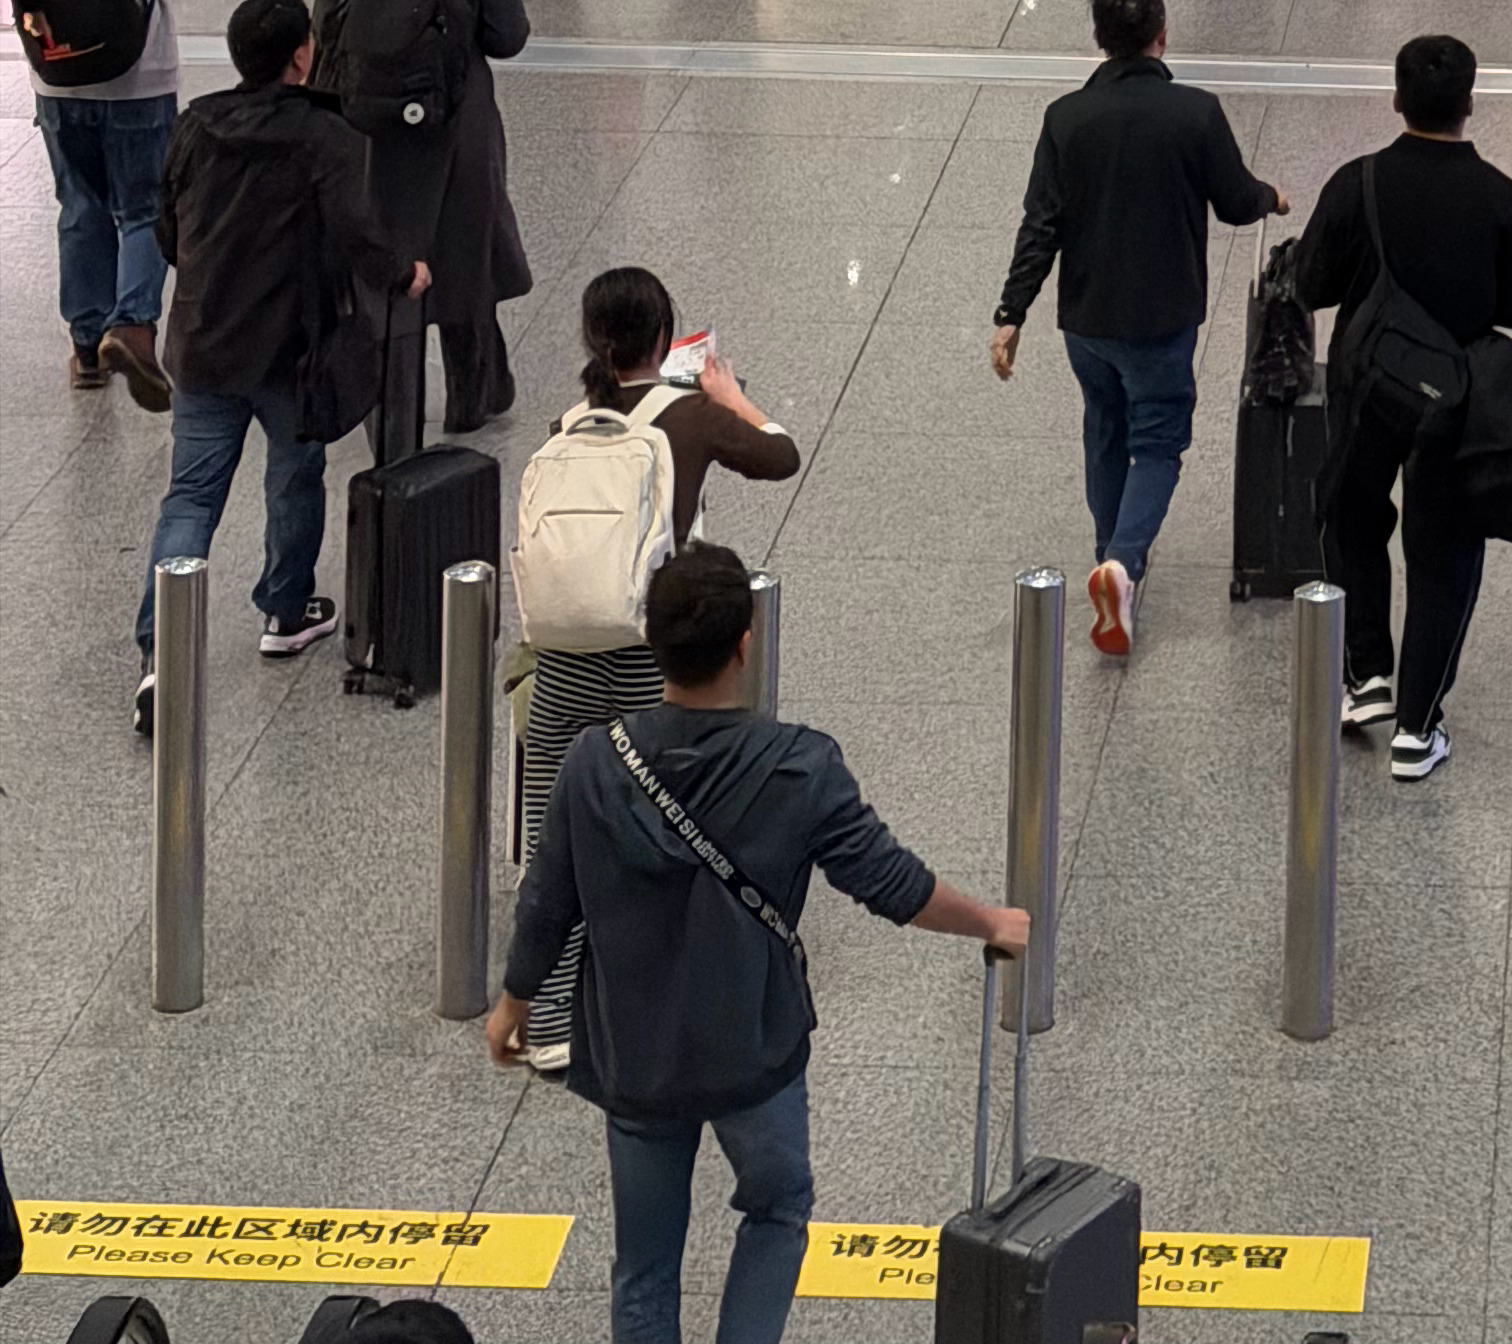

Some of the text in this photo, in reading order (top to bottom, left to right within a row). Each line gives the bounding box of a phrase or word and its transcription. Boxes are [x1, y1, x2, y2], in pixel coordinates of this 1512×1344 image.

[27, 1211, 491, 1247] 请勿在此区域内停留
[67, 1243, 417, 1272] Please Keep Clear
